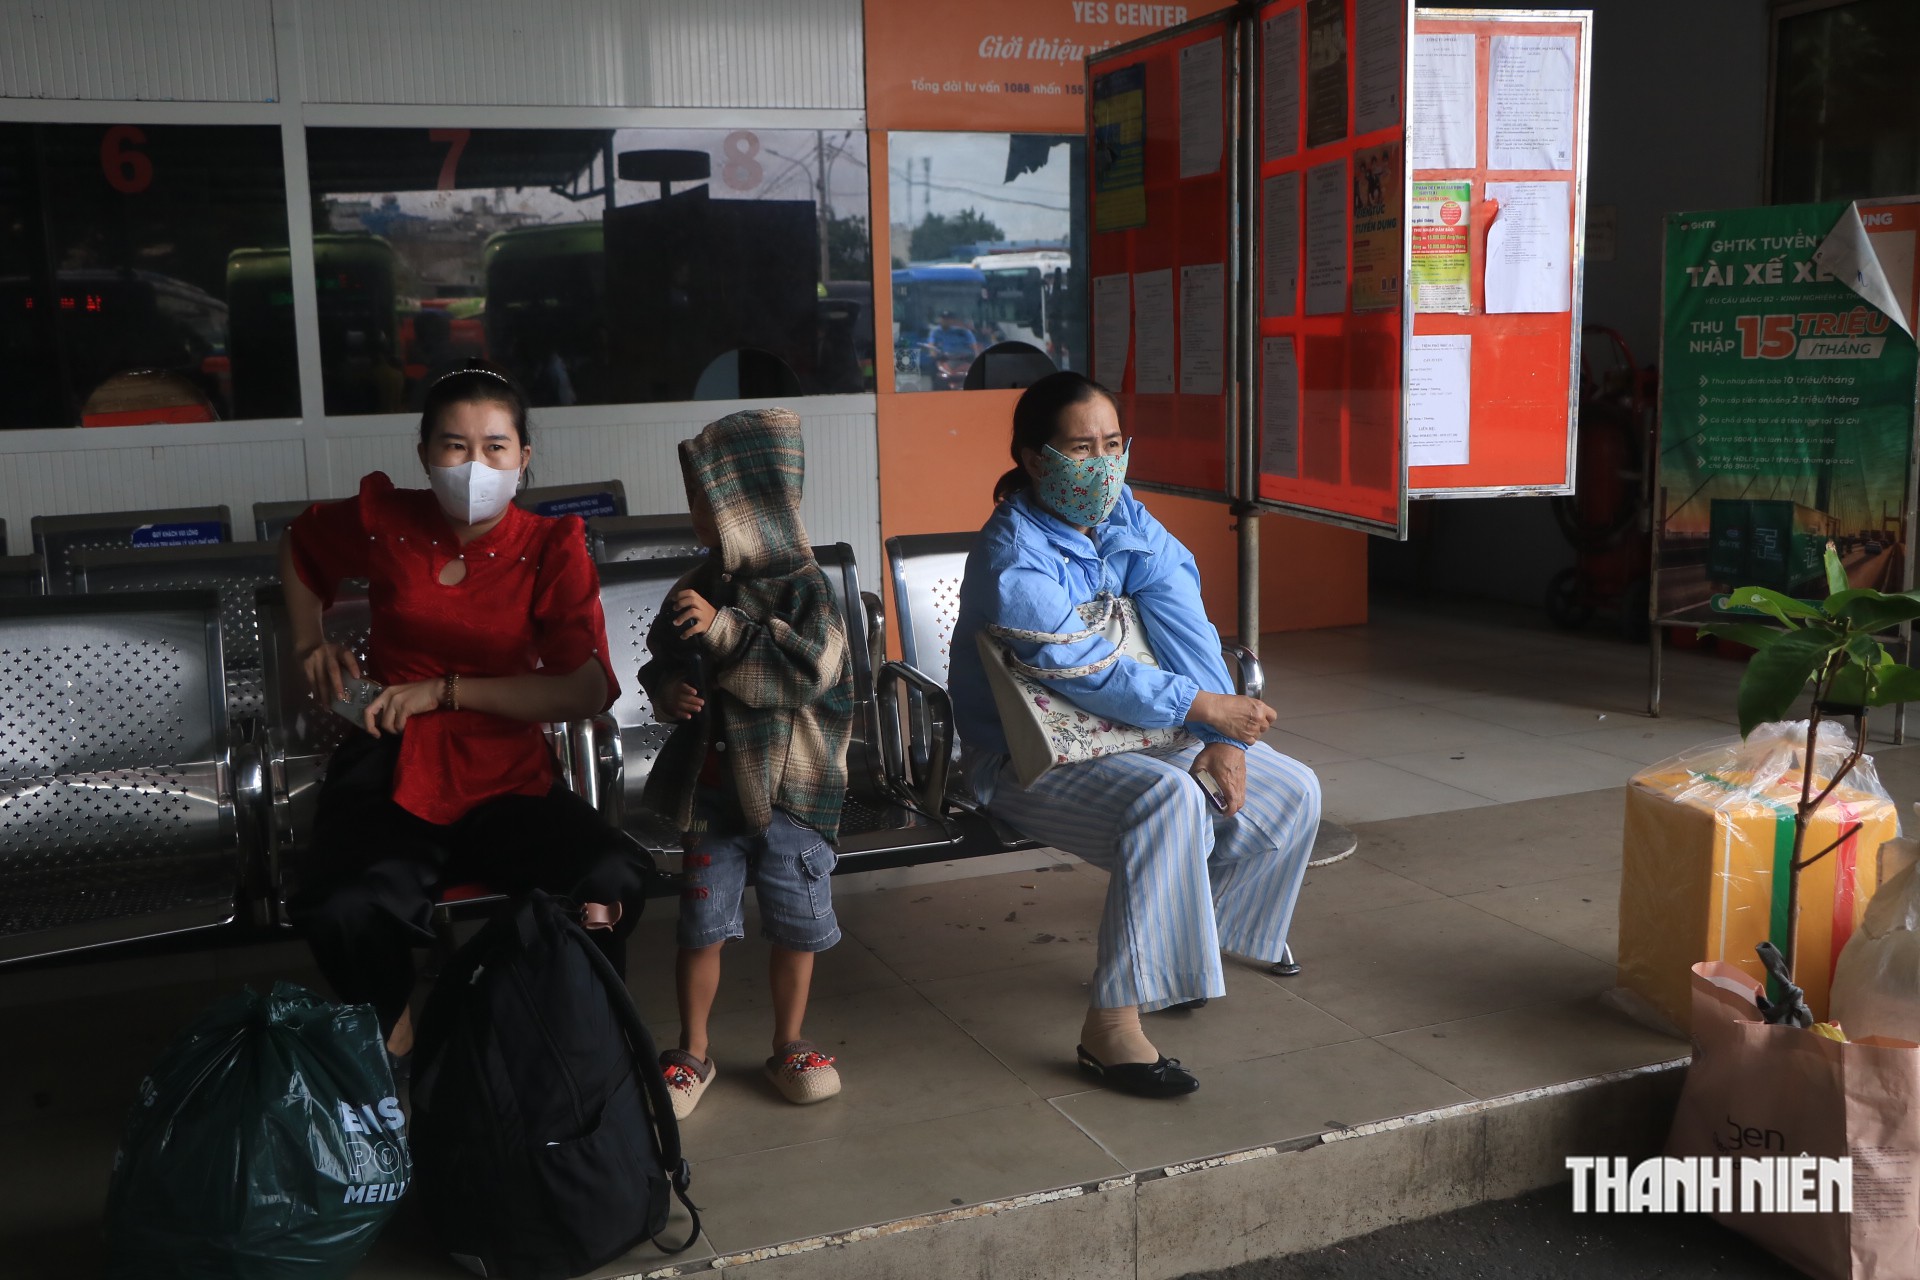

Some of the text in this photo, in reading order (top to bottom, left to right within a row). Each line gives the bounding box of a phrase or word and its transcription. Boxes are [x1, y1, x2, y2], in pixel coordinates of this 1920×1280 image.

[1072, 1, 1188, 27] YES CENTER
[978, 35, 1024, 59] Giới
[1027, 38, 1085, 66] thiệu
[911, 77, 940, 94] Tổng
[943, 80, 962, 92] đài
[965, 81, 977, 92] tư
[979, 80, 1000, 93] vấn
[100, 125, 153, 193] 6
[429, 128, 470, 191] 7
[722, 131, 763, 191] 8
[1691, 220, 1717, 230] GHTK
[1711, 228, 1817, 253] GHTK TUYỂN
[1686, 260, 1733, 287] TÀI
[1743, 253, 1788, 286] XẾ
[1690, 305, 1891, 360] THU 15 TRIỆU
[1689, 337, 1872, 356] NHẬP /THÁNG
[1784, 376, 1794, 384] 10
[1796, 376, 1855, 386] triệu/tháng
[1792, 395, 1799, 404] 2
[1800, 395, 1860, 406] triệu/tháng
